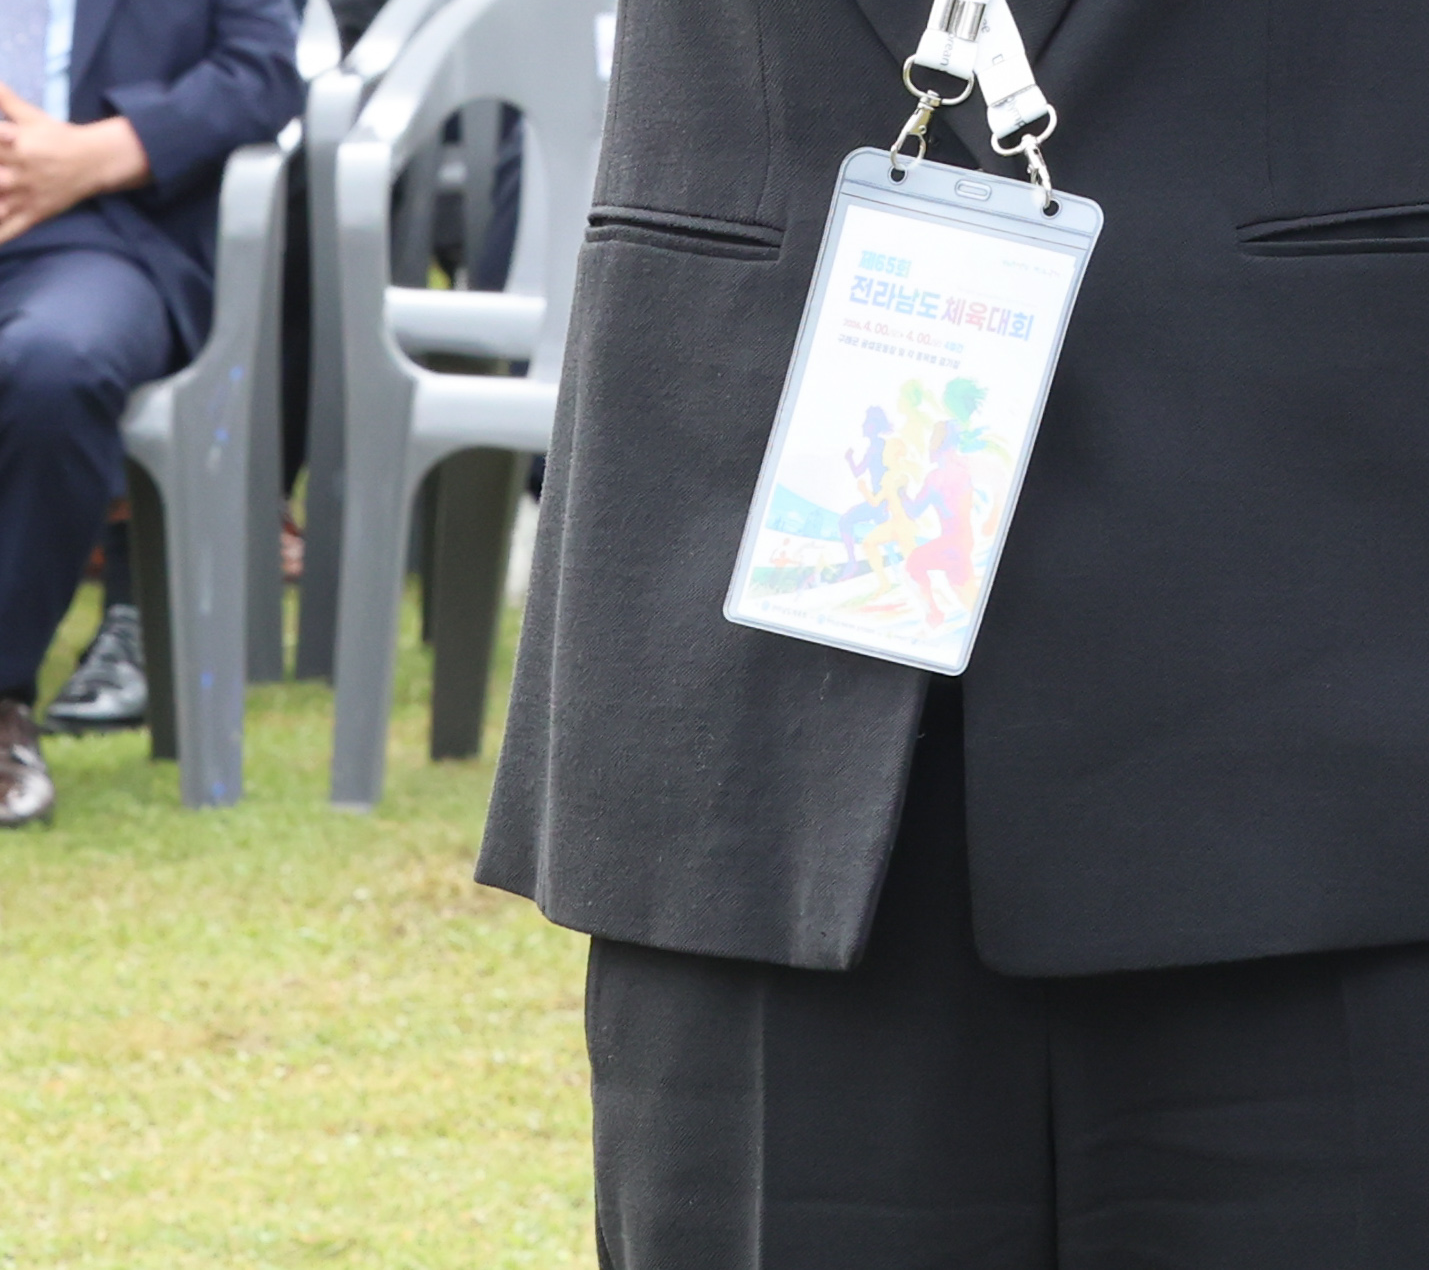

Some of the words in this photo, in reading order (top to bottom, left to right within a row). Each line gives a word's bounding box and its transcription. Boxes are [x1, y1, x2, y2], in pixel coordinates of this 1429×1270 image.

[857, 249, 913, 278] 제65회
[848, 275, 942, 320] 전라남도
[940, 296, 1036, 343] 체육대회
